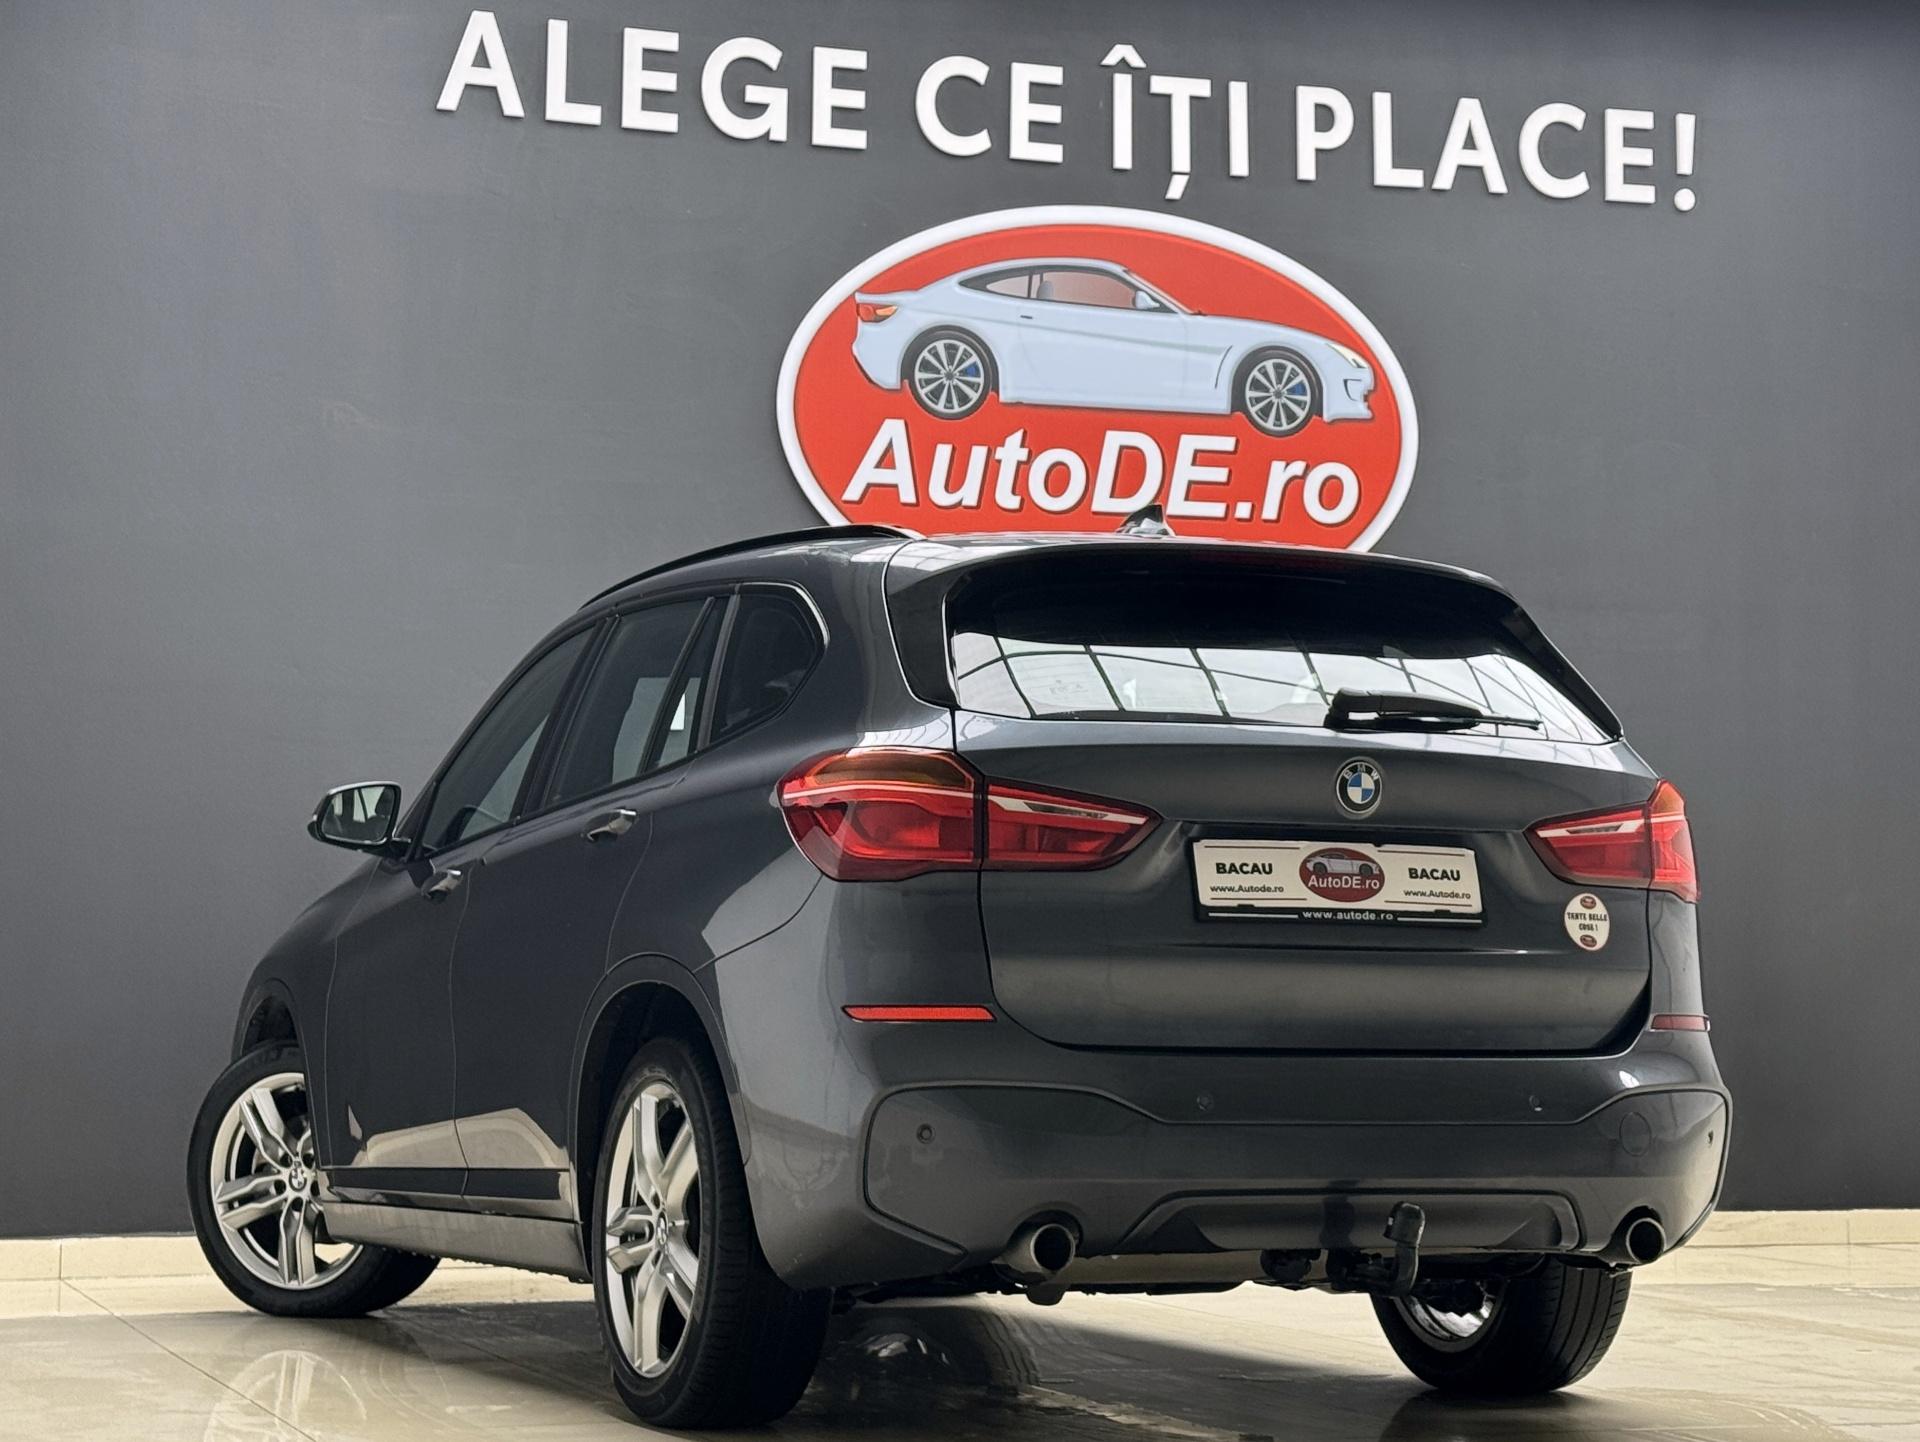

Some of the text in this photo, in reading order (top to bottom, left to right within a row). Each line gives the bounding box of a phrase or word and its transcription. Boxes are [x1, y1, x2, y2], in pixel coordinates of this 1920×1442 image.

[435, 9, 868, 149] ALEGE
[915, 54, 1063, 163] CE
[1296, 85, 1696, 212] PLACE!
[842, 417, 1360, 526] AutoDE.ro
[1343, 762, 1380, 780] BMW
[1215, 862, 1273, 875] BACAU
[1408, 867, 1461, 882] BACAU
[1209, 884, 1285, 894] www.Autode.ro
[1307, 874, 1380, 890] AutoDE.ro
[1403, 888, 1471, 900] www.Autode.ro
[1302, 910, 1394, 921] www.autode.ro
